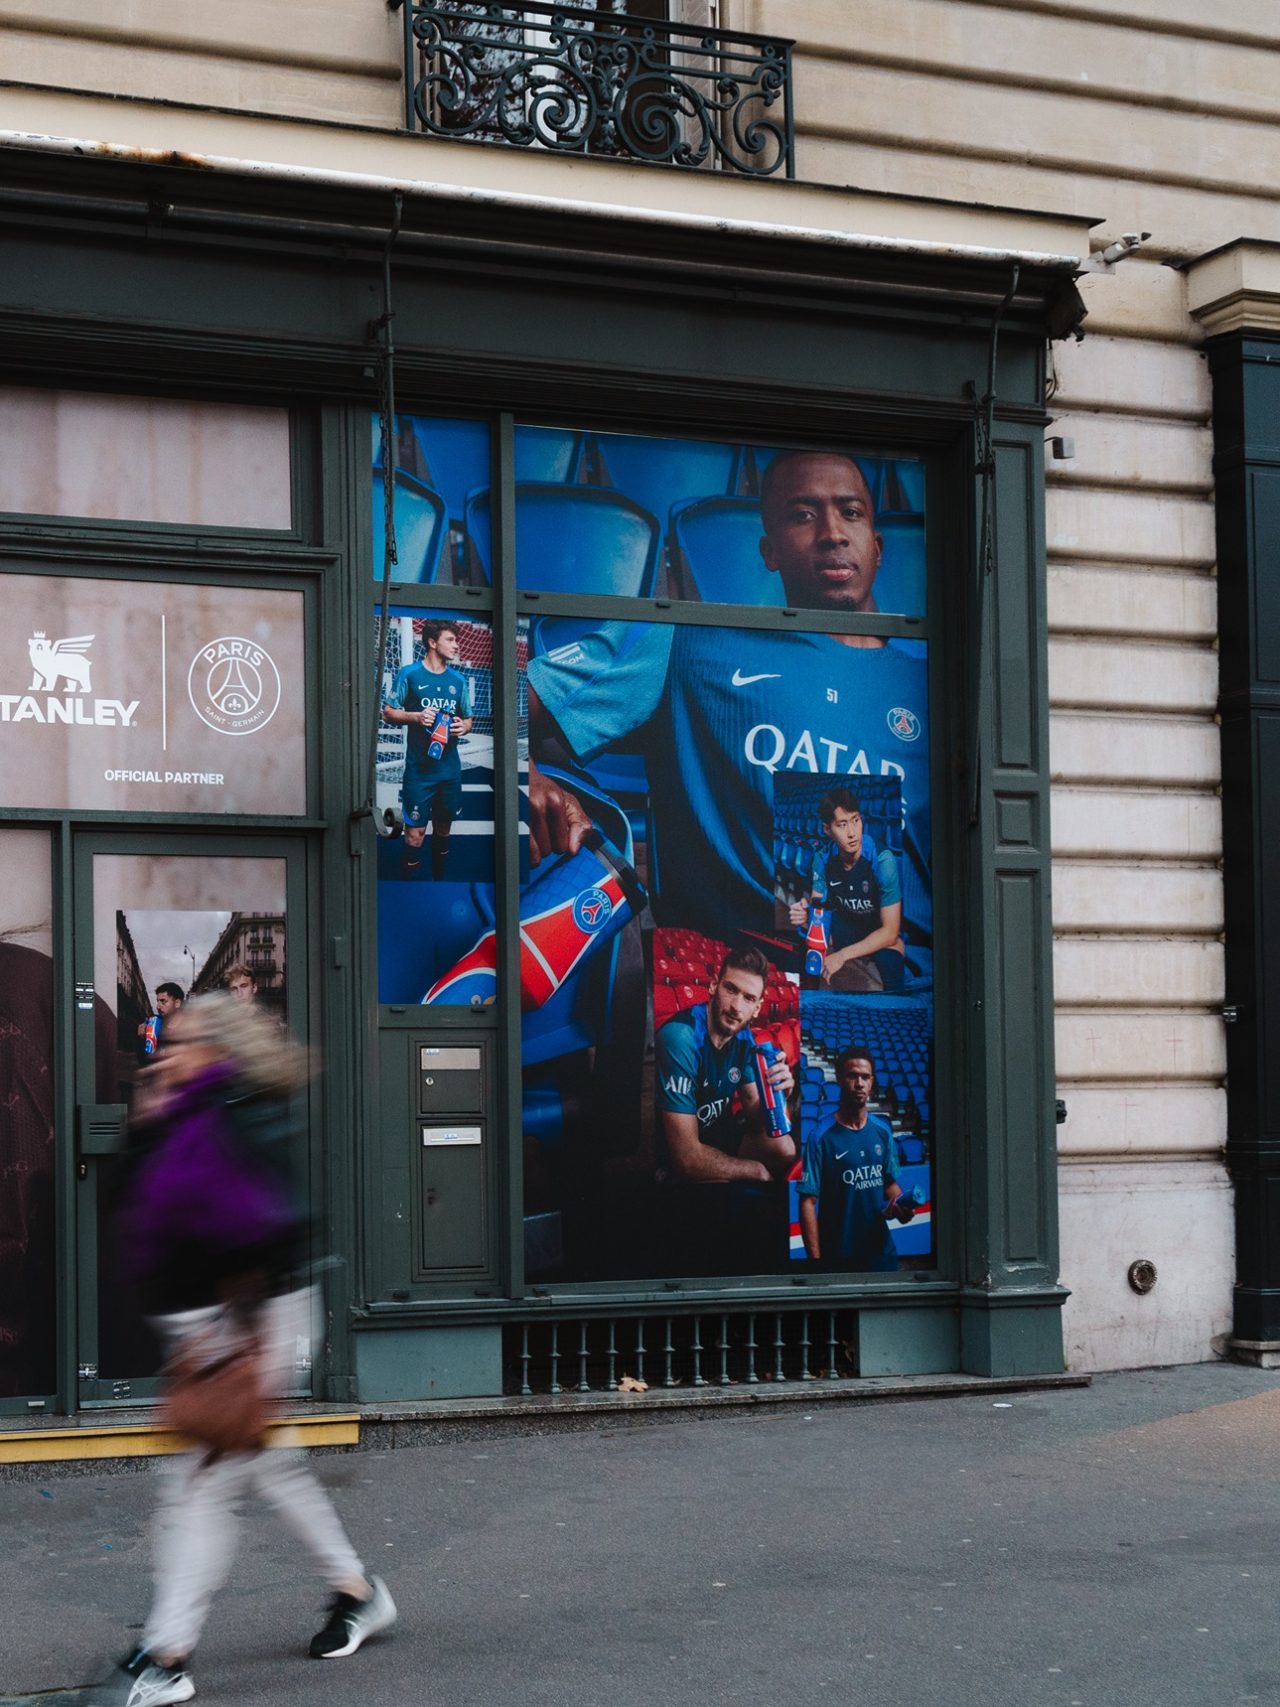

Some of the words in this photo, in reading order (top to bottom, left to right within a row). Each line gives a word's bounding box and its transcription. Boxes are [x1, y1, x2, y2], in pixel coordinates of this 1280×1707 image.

[203, 642, 264, 666] PARIS
[421, 697, 457, 710] QATAR
[105, 769, 163, 784] OFFICIAL
[165, 771, 225, 786] PARTNER
[842, 1164, 883, 1186] QATAR
